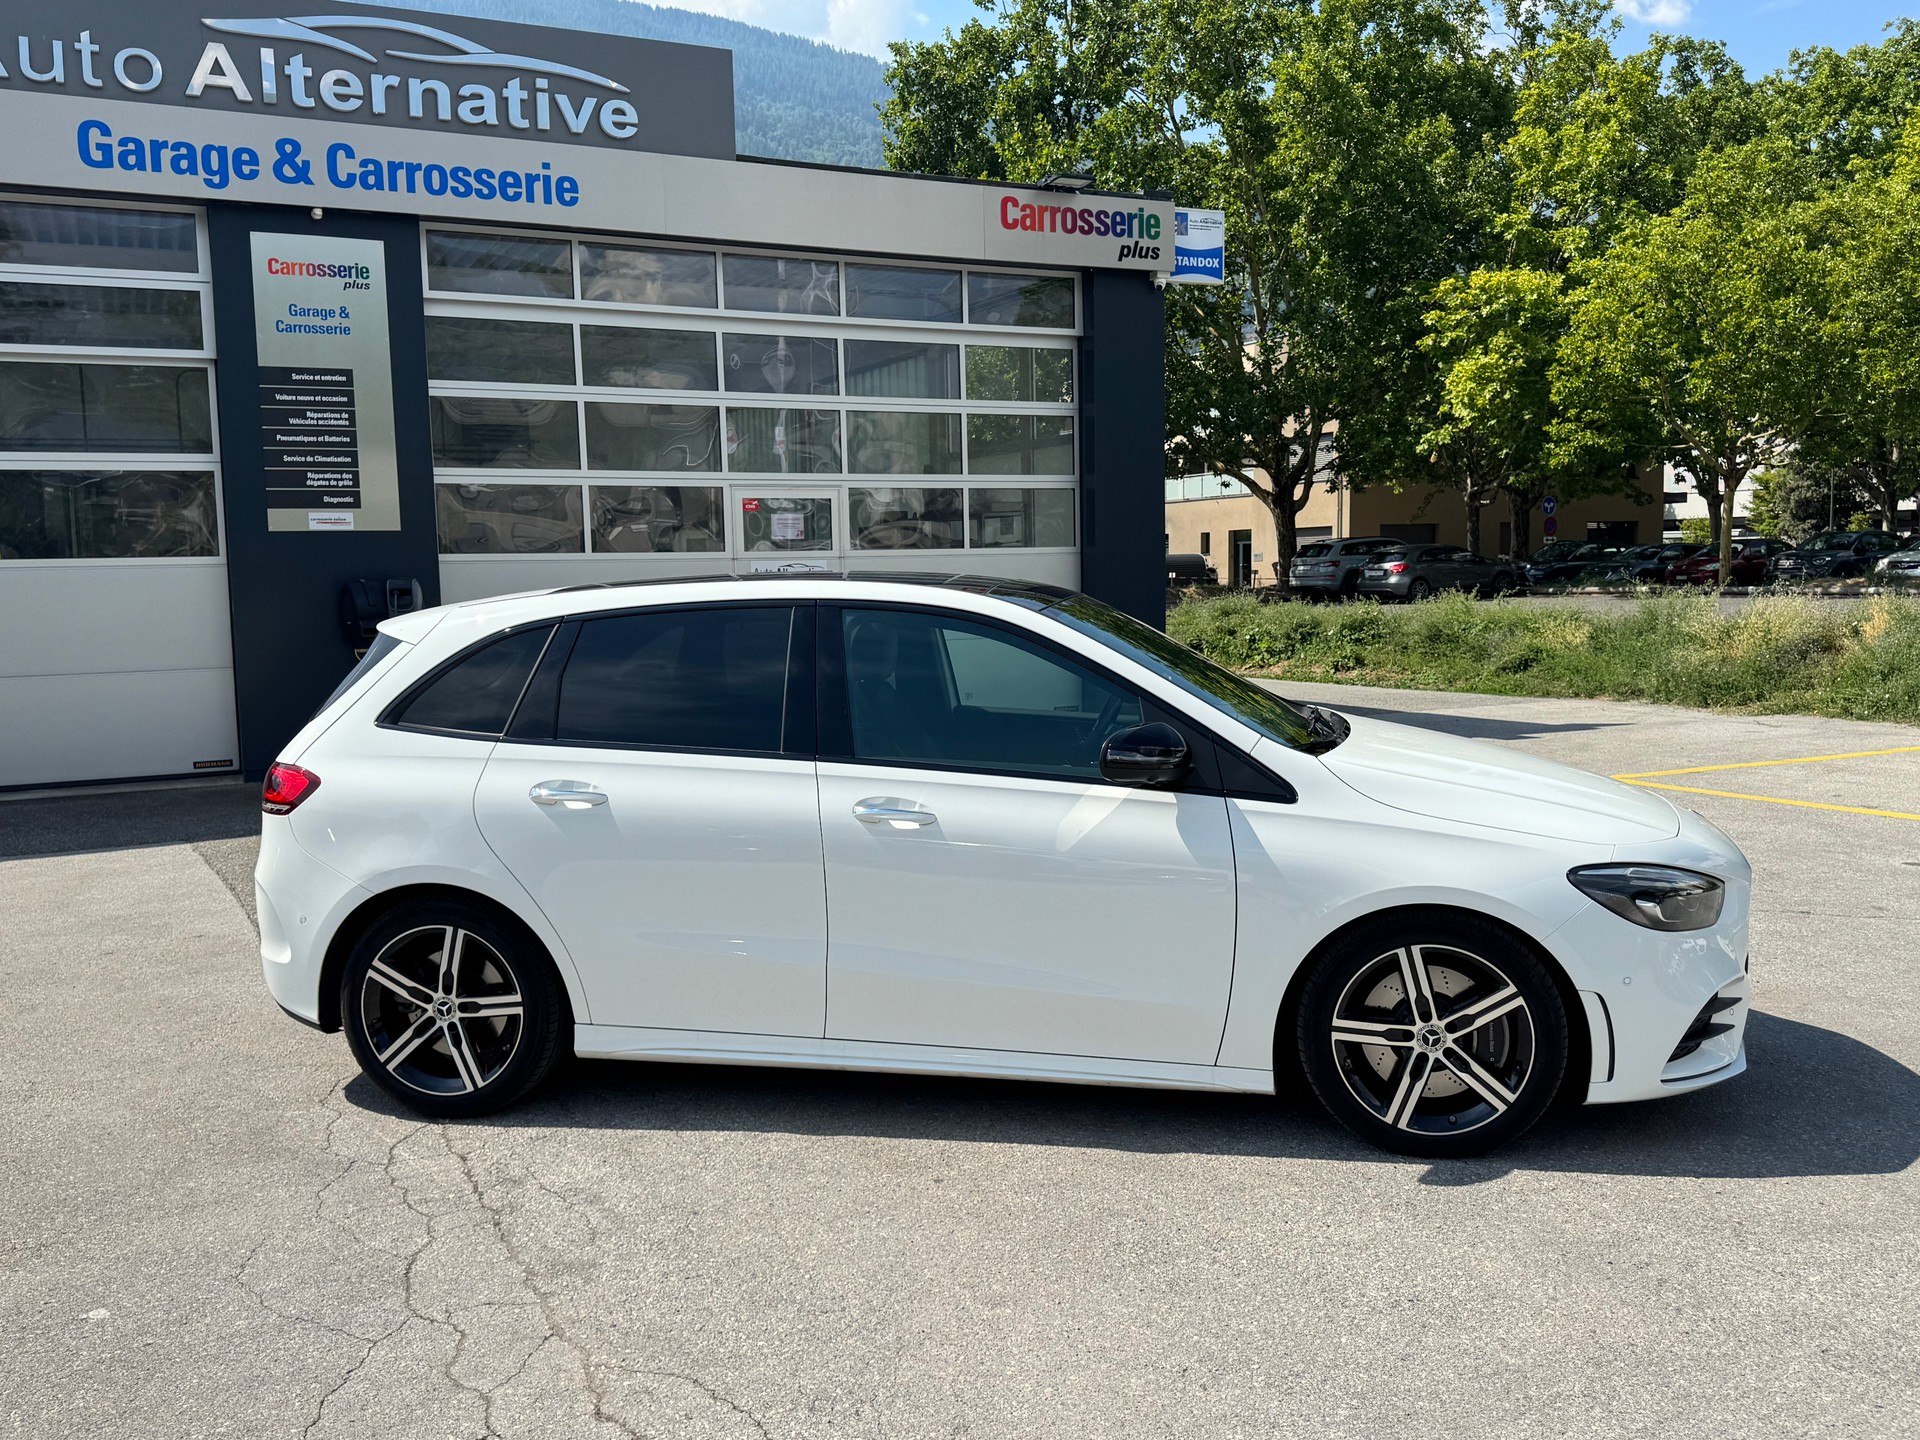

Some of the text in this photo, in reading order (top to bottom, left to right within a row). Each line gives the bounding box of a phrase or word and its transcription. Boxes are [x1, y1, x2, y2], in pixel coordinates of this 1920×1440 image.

[0, 30, 640, 139] uto Alternative
[77, 119, 580, 207] Garage & Carrosserie
[1001, 195, 1161, 240] Carrosserie
[1118, 241, 1161, 262] plus
[1175, 256, 1219, 268] TANDOX
[267, 257, 370, 280] Carrosserie
[343, 280, 370, 291] plus
[288, 303, 350, 321] Garage &
[275, 319, 351, 335] Carrosserie
[291, 373, 314, 381] Service
[275, 393, 296, 401] Voiture
[306, 411, 340, 419] Réparations
[288, 417, 317, 425] Véhicules
[276, 434, 317, 443] Pneumatiques
[307, 472, 341, 480] Réparations
[323, 496, 354, 504] Diagnostic
